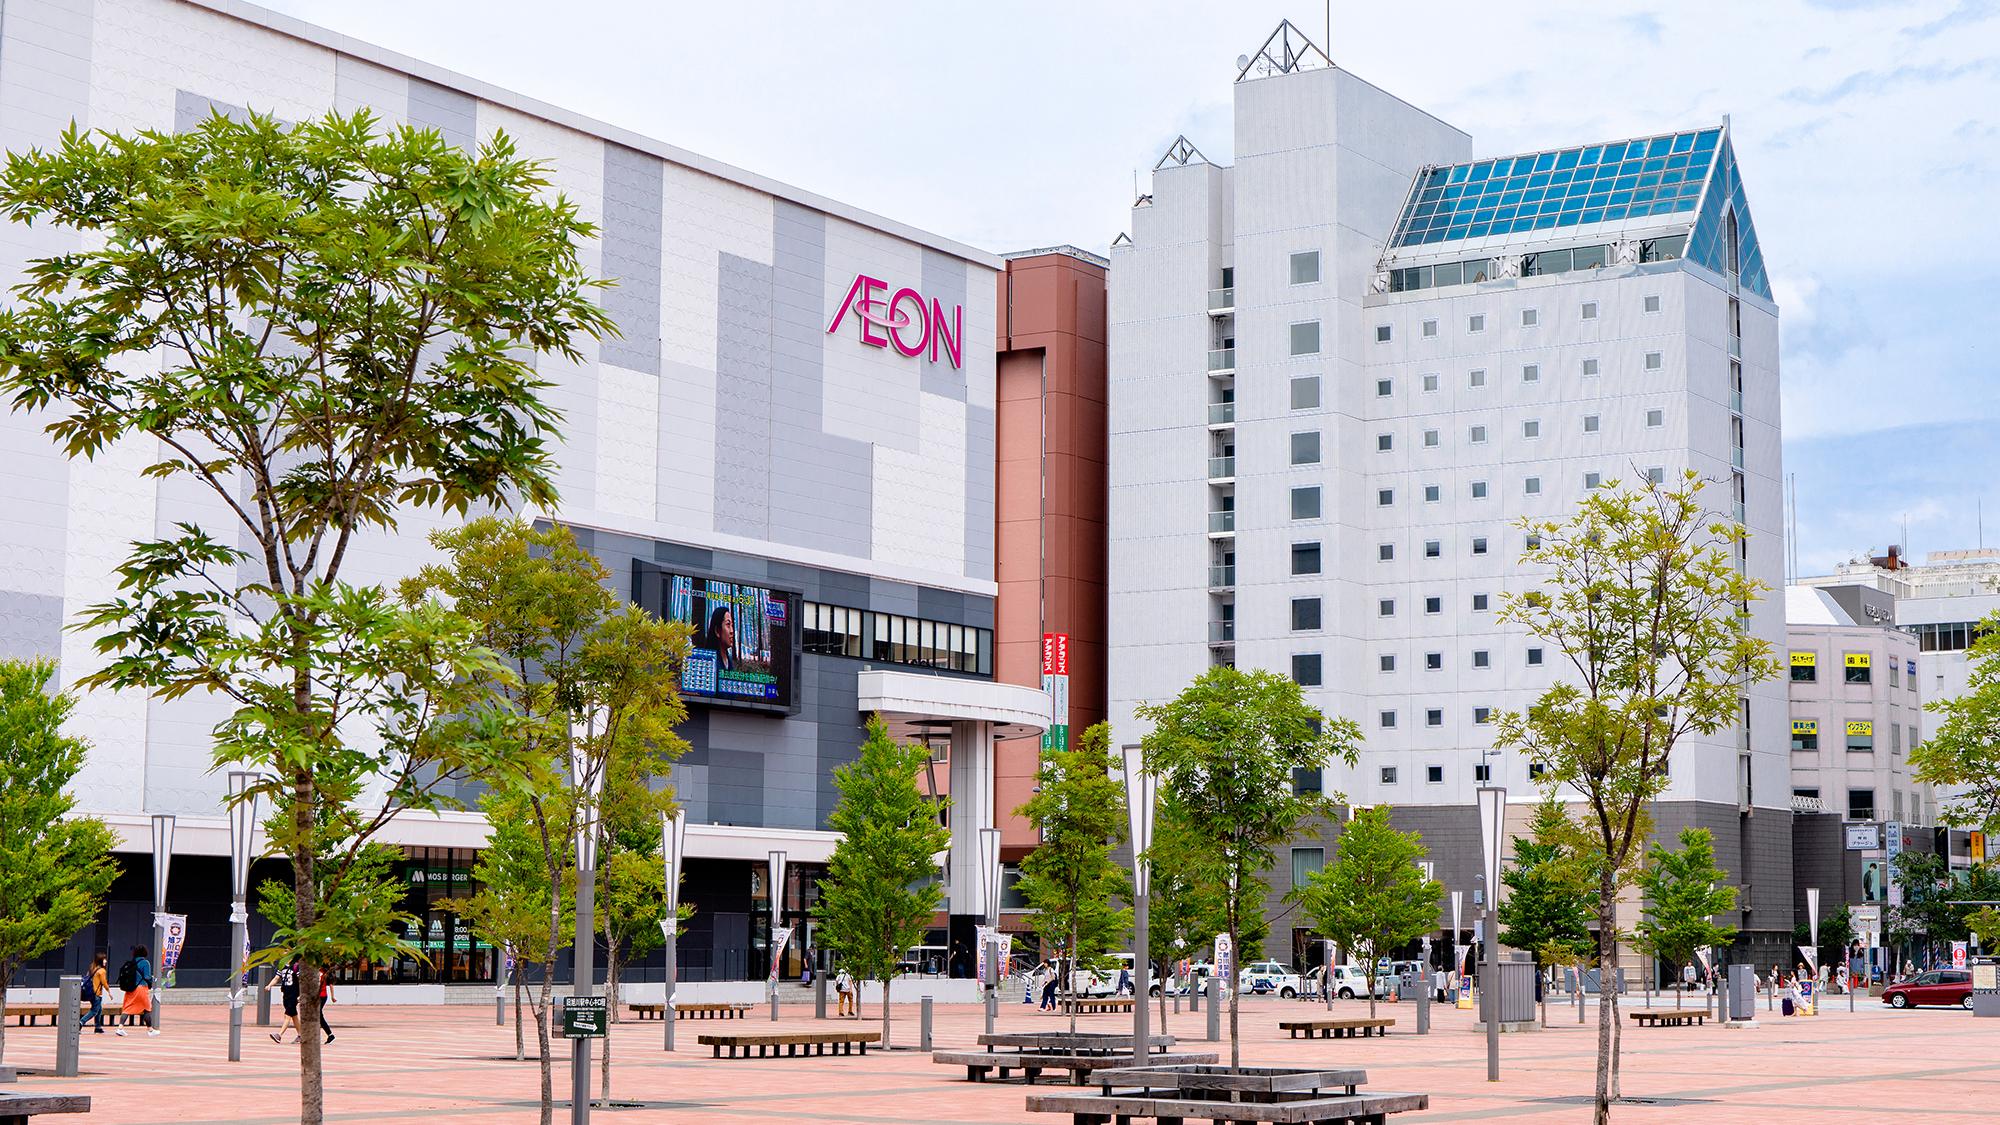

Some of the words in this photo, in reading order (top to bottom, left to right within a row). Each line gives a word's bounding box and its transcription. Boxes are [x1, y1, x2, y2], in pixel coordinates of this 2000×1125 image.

[1847, 722, 1871, 731] インプラント
[427, 873, 441, 881] MOS
